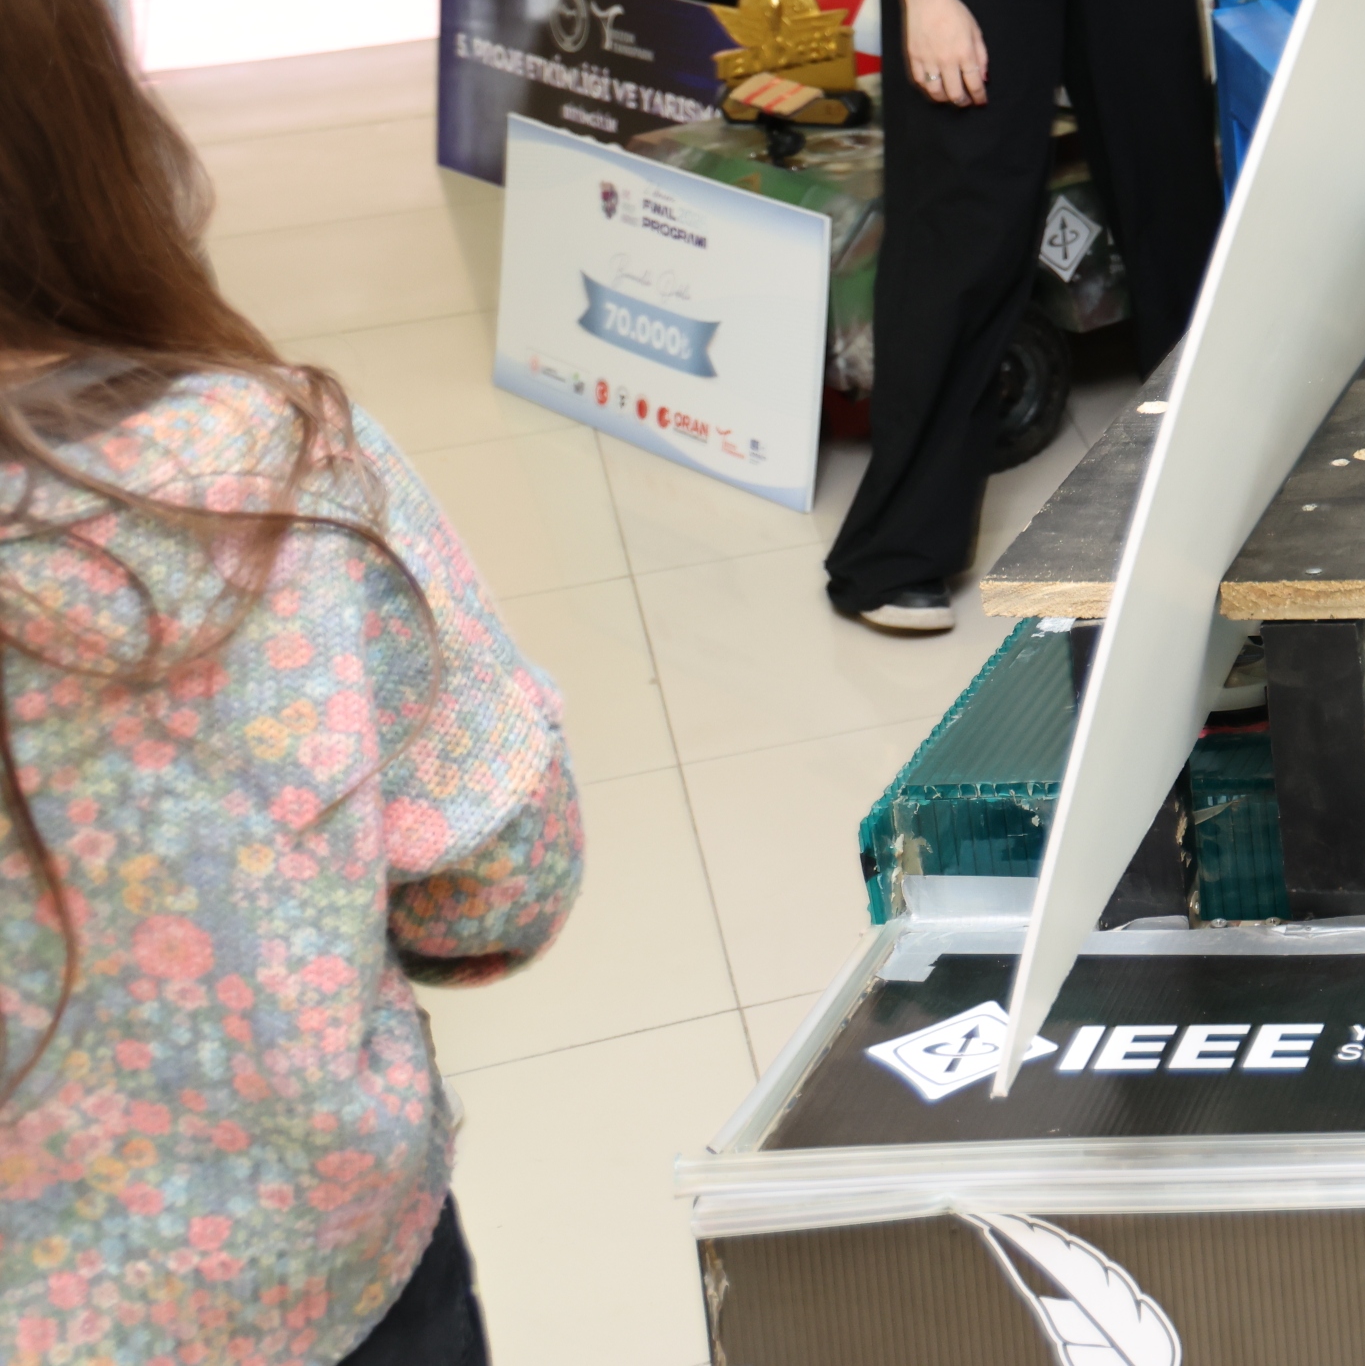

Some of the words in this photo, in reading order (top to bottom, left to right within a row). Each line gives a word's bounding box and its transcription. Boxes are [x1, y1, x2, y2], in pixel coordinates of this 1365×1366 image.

[472, 36, 524, 75] PROJE
[612, 79, 638, 109] VE
[673, 411, 710, 437] ORAN
[1057, 1022, 1326, 1072] IEEE
